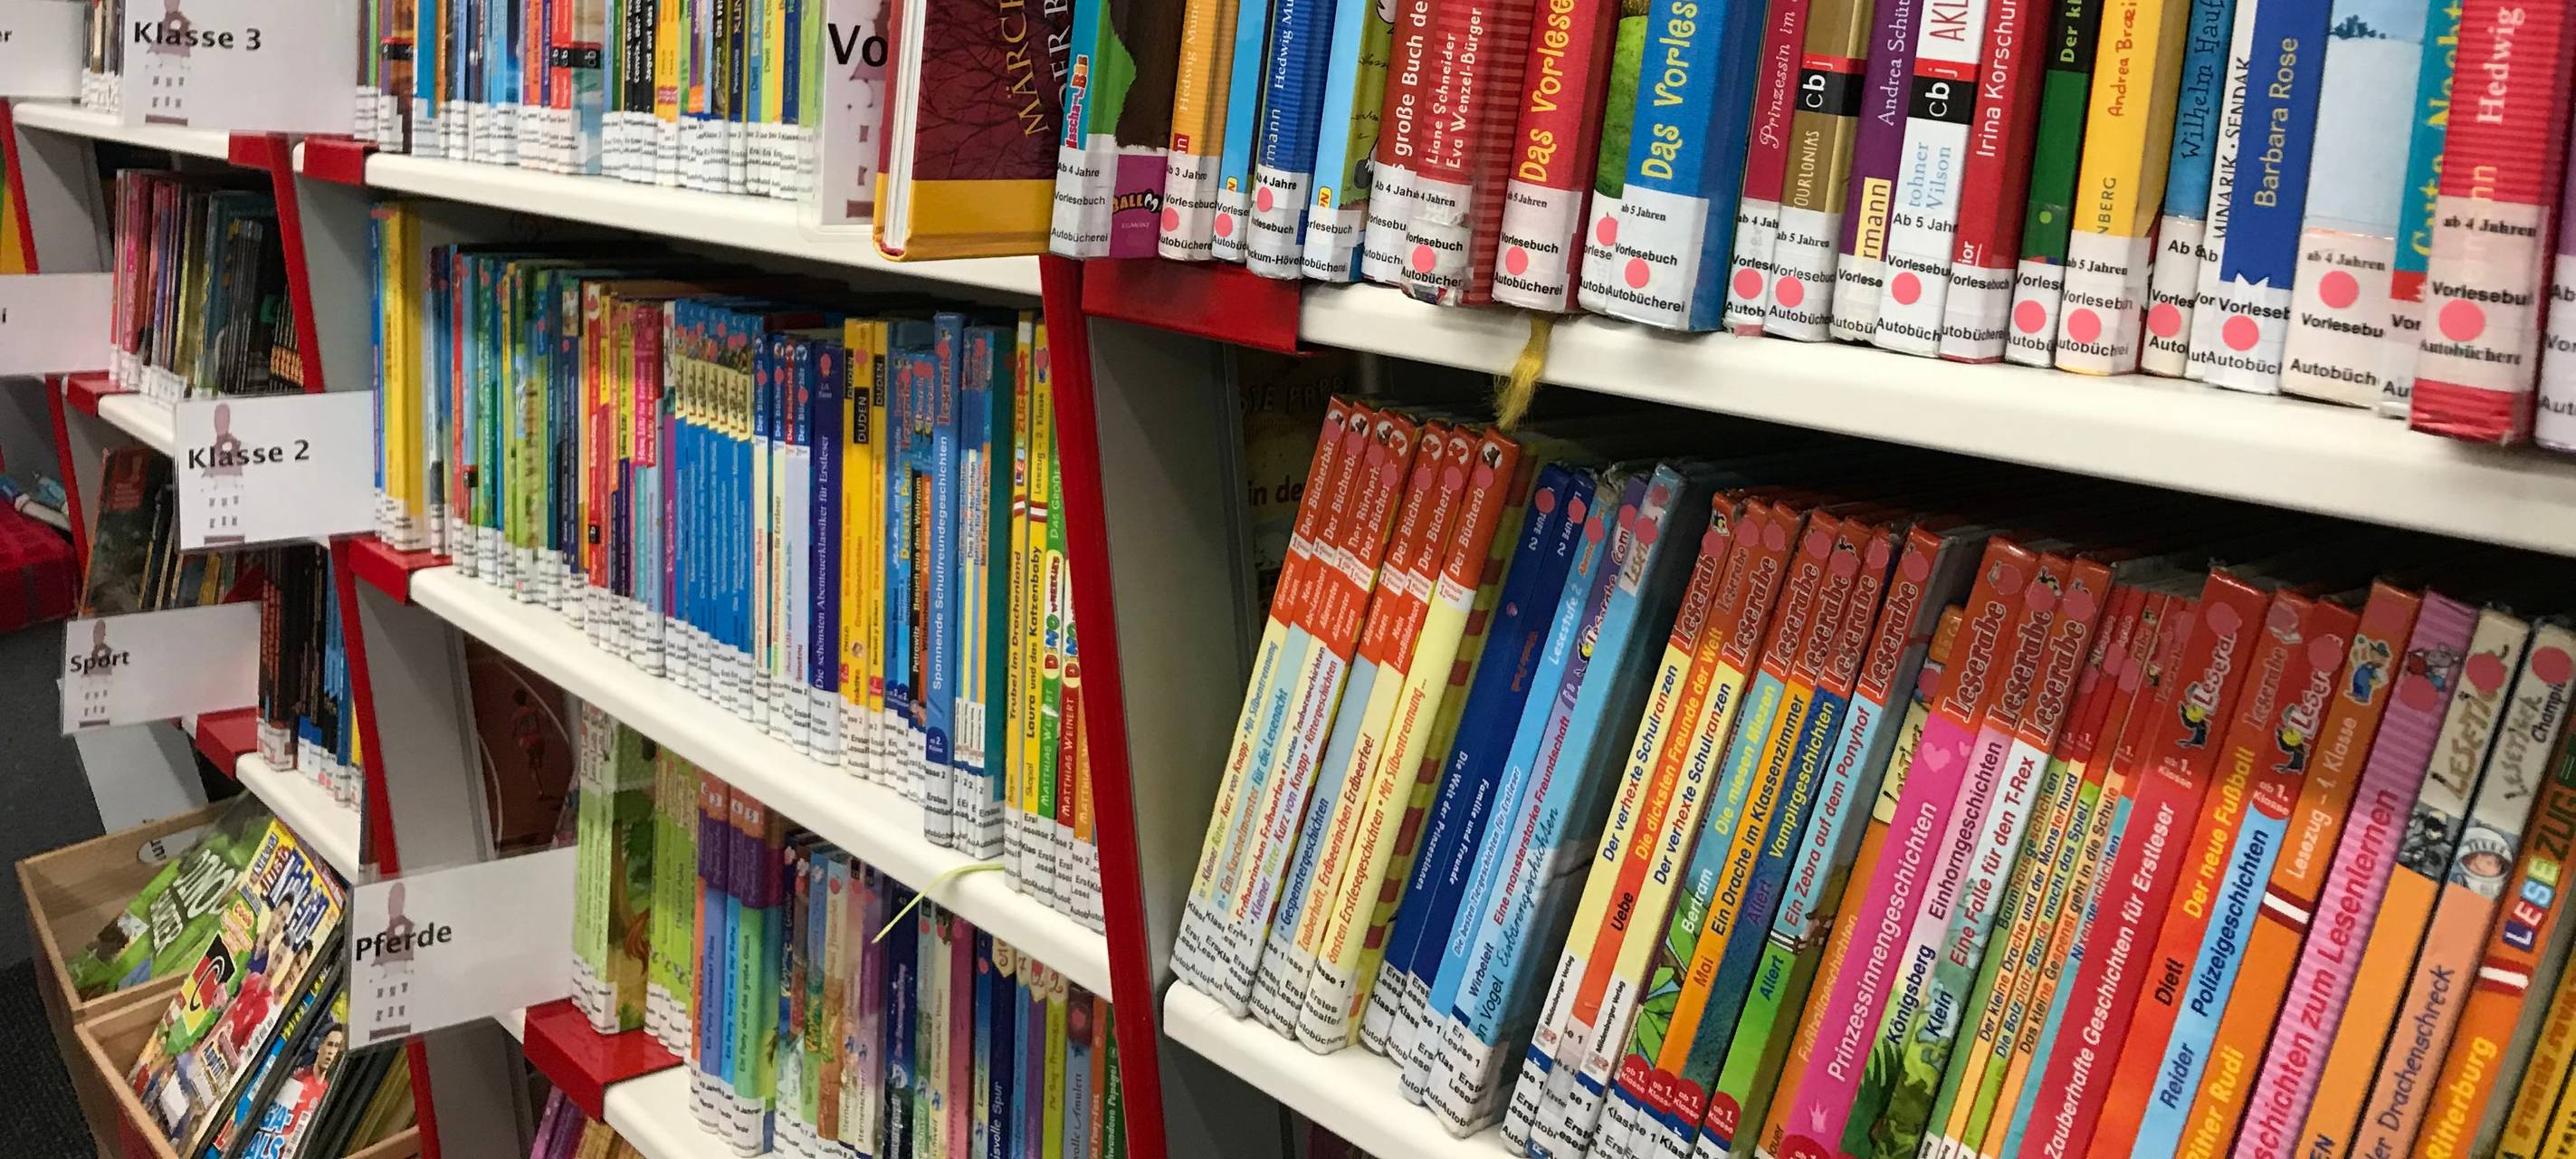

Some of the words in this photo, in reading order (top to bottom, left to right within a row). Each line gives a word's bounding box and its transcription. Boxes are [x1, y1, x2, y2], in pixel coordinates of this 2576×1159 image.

[134, 22, 234, 49] Klasse
[246, 28, 262, 51] 3
[1433, 33, 1456, 116] Schneider
[1451, 8, 1482, 133] Wenzel-Bürger
[1759, 44, 1790, 149] Prinzessin
[1779, 11, 1796, 43] im
[2108, 59, 2130, 117] Andrea
[2268, 37, 2299, 100] Rose
[2476, 7, 2525, 123] Hedwig
[1068, 165, 1073, 174] 4
[1074, 168, 1100, 177] Jahre
[1425, 121, 1442, 165] Liane
[1446, 138, 1464, 169] Eva
[2255, 107, 2288, 207] Barbara
[1052, 228, 1108, 243] Autobücherei
[1621, 204, 1630, 213] ab
[1630, 205, 1636, 215] 5
[1636, 207, 1666, 222] Jahren
[1501, 232, 1559, 254] Vorlesebuch
[1615, 243, 1678, 266] Vorlesebuch
[2168, 240, 2190, 254] Ab
[1494, 272, 1563, 295] Autobücherei
[1608, 284, 1685, 312] Autobücherei
[875, 362, 884, 406] DUDEN
[858, 396, 867, 443] DUDEN
[187, 445, 283, 470] Klasse
[294, 440, 310, 461] 2
[819, 436, 828, 483] Erstleser
[819, 485, 827, 503] für
[1300, 512, 1315, 536] Der
[1308, 439, 1334, 510] Bücherbär
[935, 436, 949, 609] Schulfreundegeschichten
[1360, 536, 1375, 560] Der
[1368, 484, 1390, 533] Bücher
[1392, 541, 1408, 565] Der
[1402, 488, 1424, 540] Bücher
[1457, 488, 1484, 550] Bücherb
[816, 505, 828, 611] Abenteuerklassiker
[1450, 553, 1465, 577] Der
[1012, 551, 1022, 646] Drachenland
[1029, 546, 1042, 637] Katzenbaby
[1723, 556, 1778, 667] Leserabe
[1764, 563, 1819, 675] Leserabe
[817, 613, 825, 666] schönsten
[933, 612, 942, 690] Spannende
[1819, 574, 1876, 692] Leserabe
[1858, 582, 1919, 699] Leserabe
[71, 649, 129, 674] Sport
[815, 667, 824, 688] Die
[1012, 653, 1017, 670] im
[1942, 601, 2007, 723] Leserabe
[1989, 609, 2054, 729] Leserabe
[2019, 619, 2085, 745] Leserabe
[1026, 694, 1036, 739] Laura
[1064, 696, 1074, 751] WEINERT
[1305, 661, 1337, 743] Rittergeschichten
[1603, 833, 1621, 862] Der
[1615, 765, 1644, 833] verhexte
[1636, 665, 1678, 763] Schulranzen
[1635, 830, 1653, 860] Die
[1646, 764, 1675, 829] dicksten
[1668, 698, 1699, 761] Freunde
[1692, 673, 1710, 695] der
[1701, 627, 1723, 665] Welt
[1715, 807, 1734, 836] Die
[1728, 745, 1755, 802] miesen
[1746, 684, 1776, 742] Miezen
[1062, 753, 1073, 818] MATTHIAS
[1289, 752, 1311, 792] Knapp
[1654, 857, 1674, 886] Der
[1666, 782, 1696, 854] verhexte
[1688, 683, 1731, 784] Schulranzen
[1769, 701, 1836, 859] Vampirgeschichten
[2004, 756, 2035, 806] T-Rex
[2212, 745, 2256, 830] Fußball
[1274, 814, 1290, 844] Kurz
[1284, 790, 1298, 814] von
[1493, 896, 1510, 926] Eine
[1505, 805, 1541, 893] monsterstarke
[1533, 715, 1570, 804] Freundschaft
[1712, 905, 1731, 935] Ein
[1722, 847, 1752, 905] Drache
[1742, 824, 1760, 848] im
[1751, 694, 1805, 823] Klassenzimmer
[1784, 897, 1803, 927] Ein
[1794, 848, 1821, 898] Zebra
[1814, 817, 1832, 848] auf
[1824, 781, 1846, 815] dem
[1836, 705, 1871, 779] Ponyhof
[1994, 809, 2016, 847] den
[2038, 772, 2078, 866] Monsterhund
[1281, 798, 1330, 926] Gespenstergeschichten
[1981, 848, 2002, 876] für
[1997, 771, 2059, 931] Baumhausgeschichten
[2131, 800, 2175, 894] Erstleser
[2199, 829, 2229, 886] neue
[1250, 877, 1271, 920] Kleiner
[1682, 868, 1713, 935] Bertram
[1749, 880, 1773, 928] Allert
[1885, 943, 1937, 1045] Königsberg
[1928, 741, 2003, 921] Einhorngeschichten
[1964, 877, 1992, 925] Falle
[2021, 893, 2037, 922] und
[2032, 868, 2046, 891] der
[2182, 889, 2204, 920] Der
[1611, 891, 1635, 933] Uebe
[2121, 901, 2145, 938] für
[357, 923, 452, 961] Pferde
[1827, 800, 1939, 1082] Prinzessinnengeschichten
[1951, 925, 1975, 967] Eine
[2002, 924, 2027, 972] Drache
[1467, 942, 1496, 997] Wirbeleit
[1544, 979, 1566, 1026] Mildenberger
[1562, 955, 1575, 979] Verlag
[1693, 957, 1714, 989] Mai
[1759, 955, 1784, 1001] Allert
[2082, 926, 2135, 1047] Geschichten
[2153, 957, 2186, 1006] Dietl
[2160, 1042, 2196, 1111] Reider
[2190, 829, 2269, 1018] Polizeigeschichten
[1480, 976, 1504, 1020] Vogel
[1596, 1004, 1617, 1053] Mildenberger
[1614, 981, 1627, 1004] Verlag
[1924, 990, 1953, 1039] Klein
[1980, 1018, 1995, 1042] Der
[2377, 964, 2456, 1130] Drachenschreck
[992, 1081, 1005, 1115] Spur
[2044, 1049, 2094, 1159] Zauberhafte
